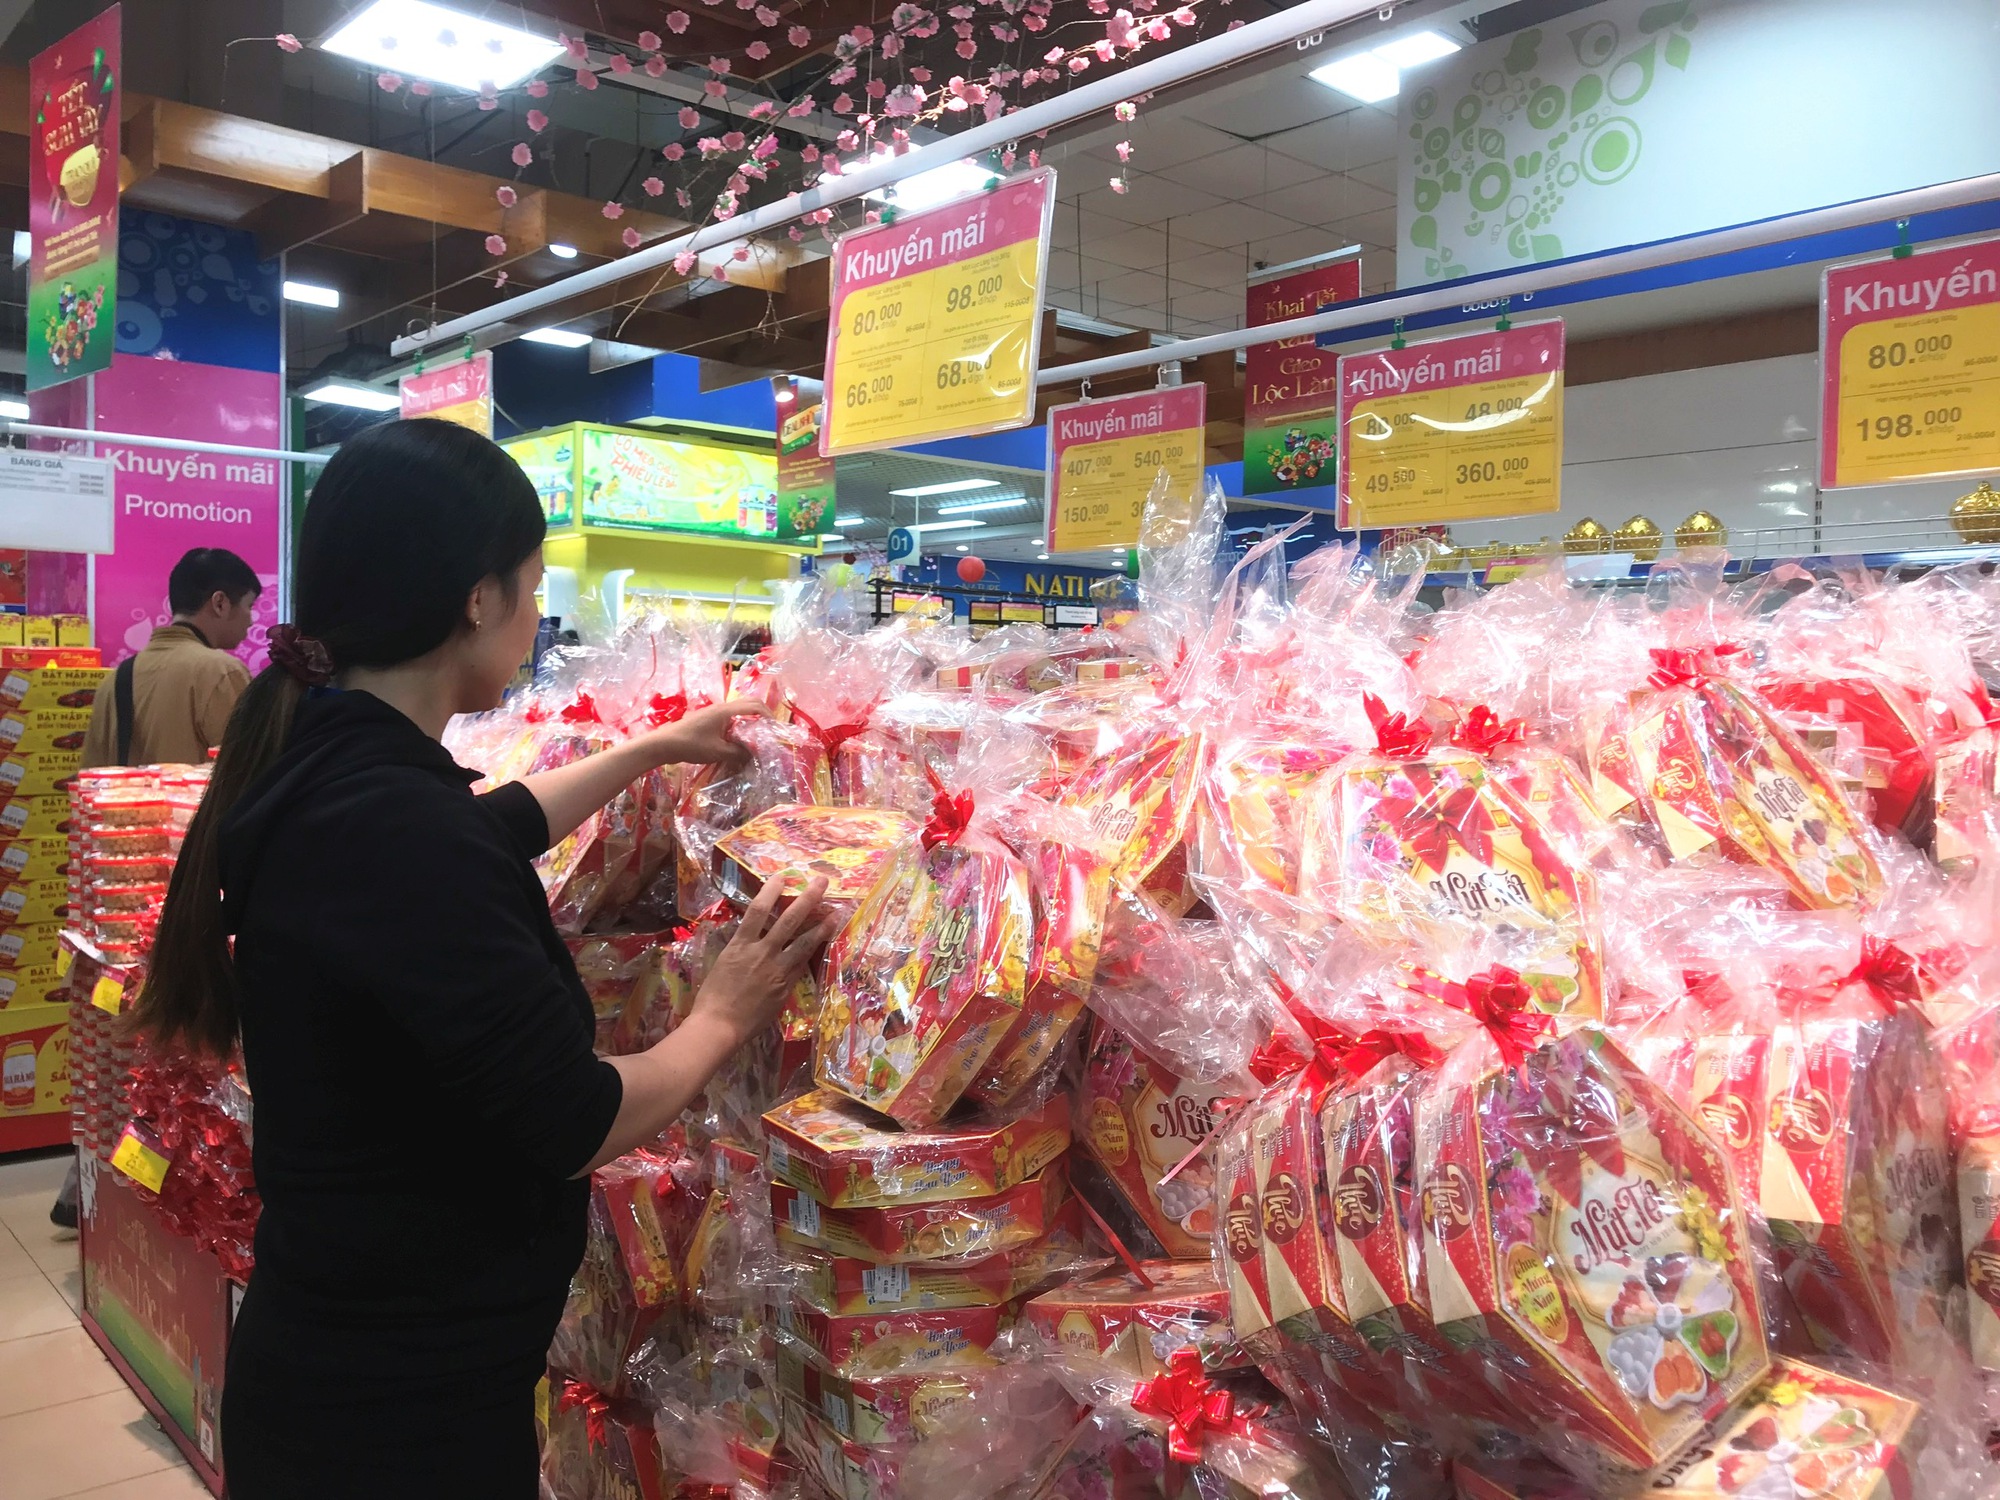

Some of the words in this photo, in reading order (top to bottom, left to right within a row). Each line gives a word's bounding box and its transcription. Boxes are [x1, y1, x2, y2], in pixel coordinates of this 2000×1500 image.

[845, 226, 933, 283] Khuyến
[940, 211, 986, 256] mãi
[946, 274, 1003, 313] 98.000
[1844, 258, 1997, 316] Khuyến
[853, 301, 902, 337] 80.000
[1265, 297, 1306, 322] Khai
[1280, 357, 1321, 375] Gieo
[1868, 334, 1953, 370] 80.000
[1351, 354, 1445, 394] Khuyến
[1454, 347, 1502, 378] mãi
[846, 374, 894, 408] 66.000
[1252, 383, 1290, 405] Lộc
[1291, 376, 1336, 399] Làn
[1061, 408, 1126, 440] Khuyến
[1131, 405, 1163, 430] mãi
[1856, 406, 1962, 442] 198.000
[104, 448, 216, 482] Khuyến
[225, 461, 275, 485] mãi
[1067, 455, 1112, 477] 407.000
[1133, 445, 1183, 469] 540.000
[1456, 456, 1529, 485] 360.000
[1365, 468, 1416, 493] 49.500
[124, 494, 252, 524] Promotion
[1063, 503, 1109, 523] 150.000
[891, 534, 909, 551] 01
[1150, 1094, 1214, 1146] Mứt
[922, 1156, 961, 1174] Happy
[940, 1168, 969, 1188] Year
[1263, 1173, 1304, 1236] Phúc
[1337, 1166, 1382, 1231] Phúc
[1570, 1198, 1645, 1276] Mứt
